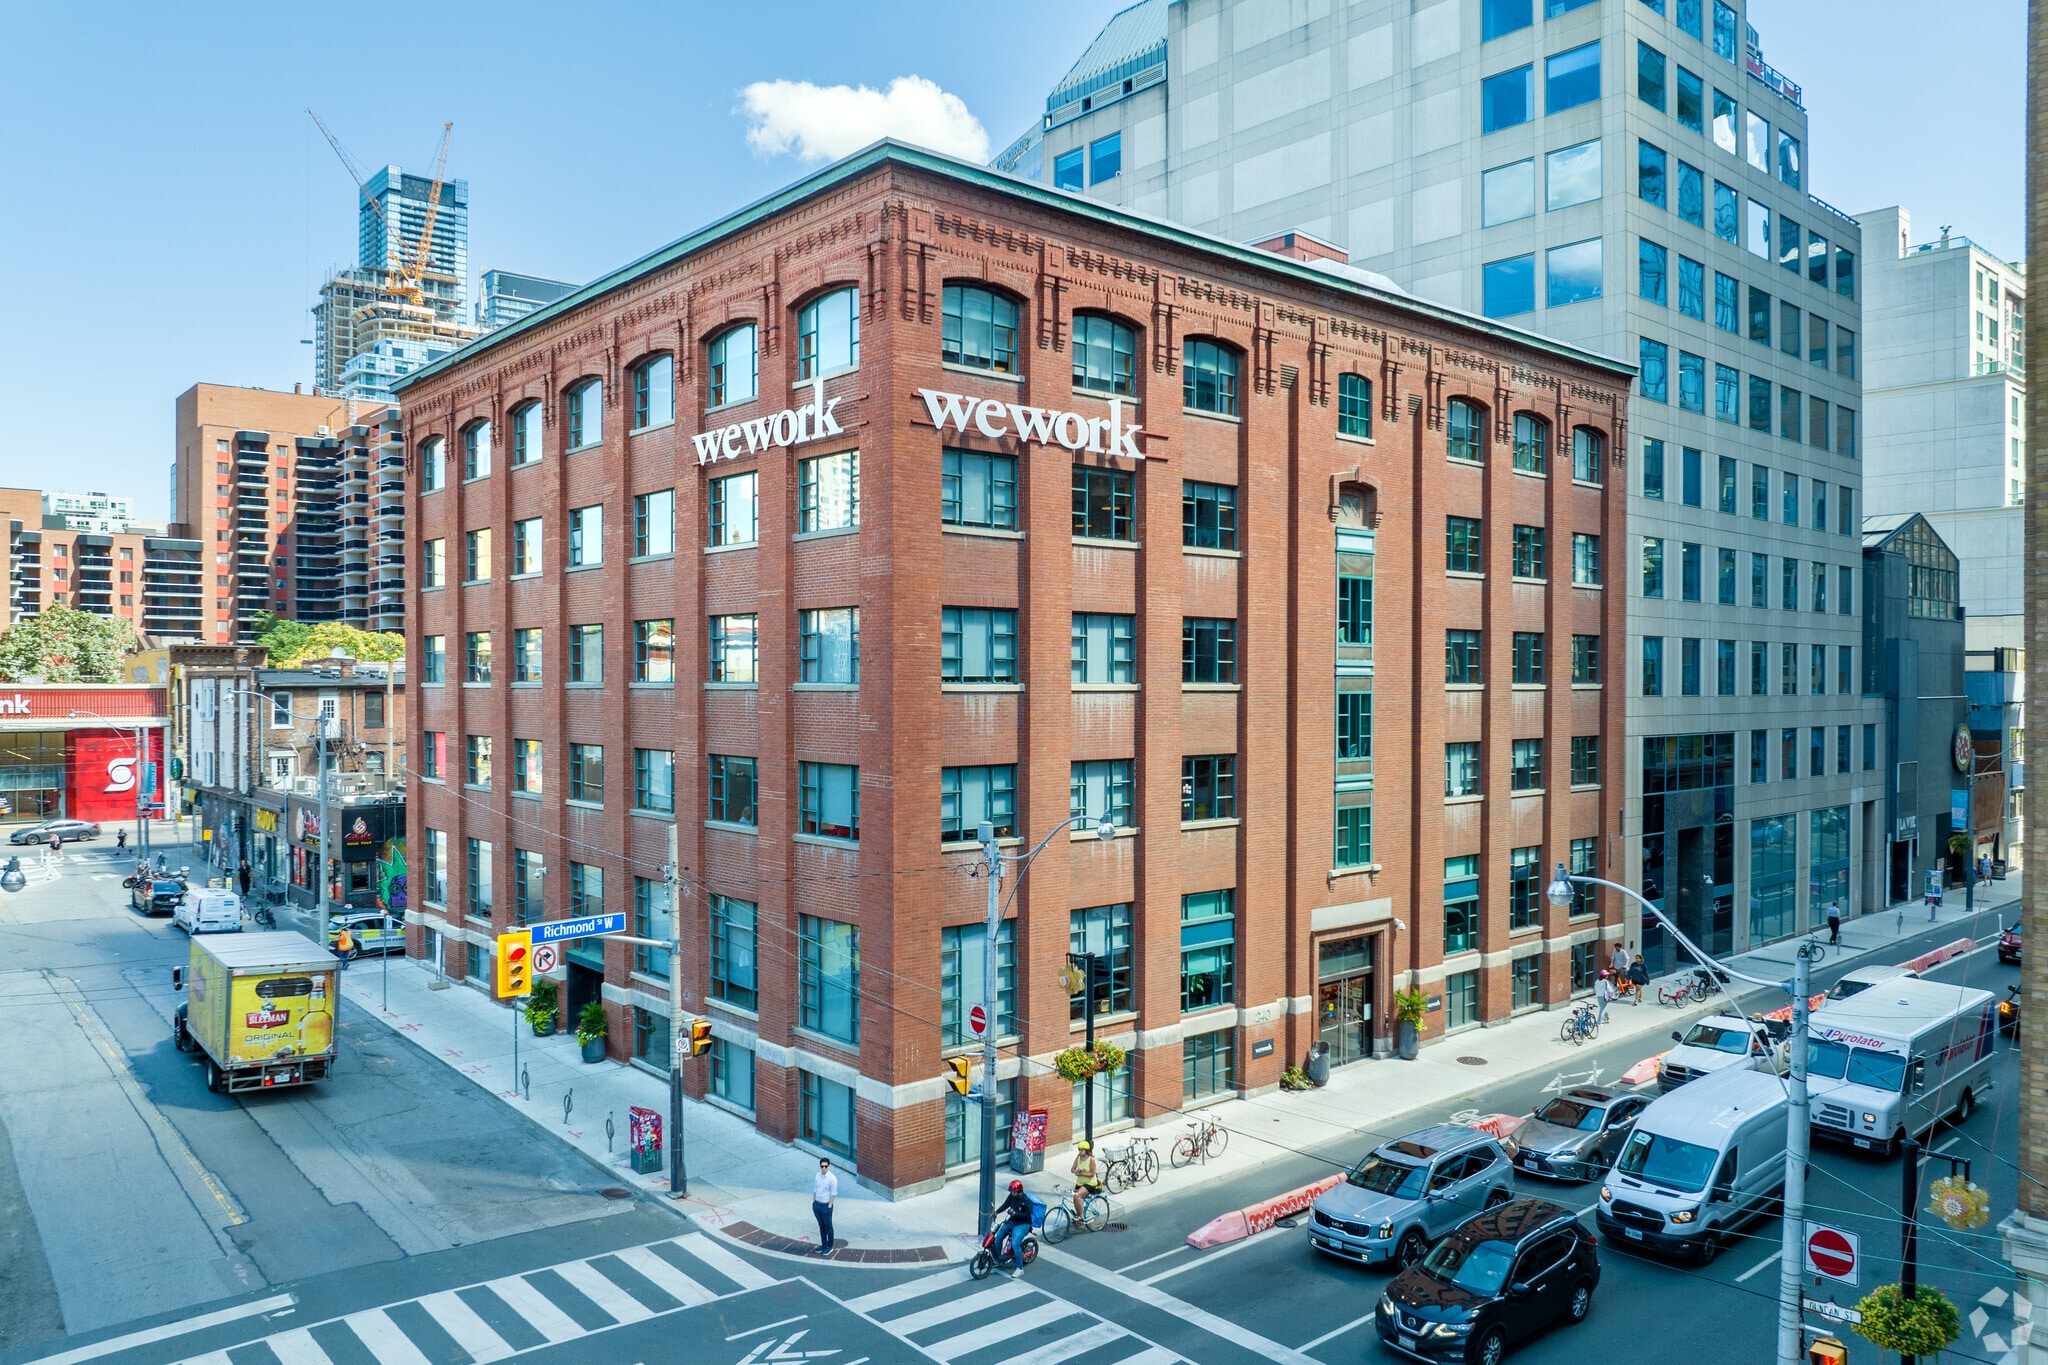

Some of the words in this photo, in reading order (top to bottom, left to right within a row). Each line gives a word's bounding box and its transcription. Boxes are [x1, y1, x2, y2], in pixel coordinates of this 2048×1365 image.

[692, 376, 844, 466] wework
[917, 388, 1146, 459] wework
[256, 808, 277, 832] RUDY
[543, 919, 595, 938] Richmond
[604, 917, 613, 929] W
[1255, 1009, 1271, 1023] 240
[244, 1032, 295, 1042] ORIGINAL
[1831, 1030, 1886, 1048] Purolator
[1809, 1301, 1840, 1317] DUNCAN
[1844, 1310, 1853, 1321] ST
